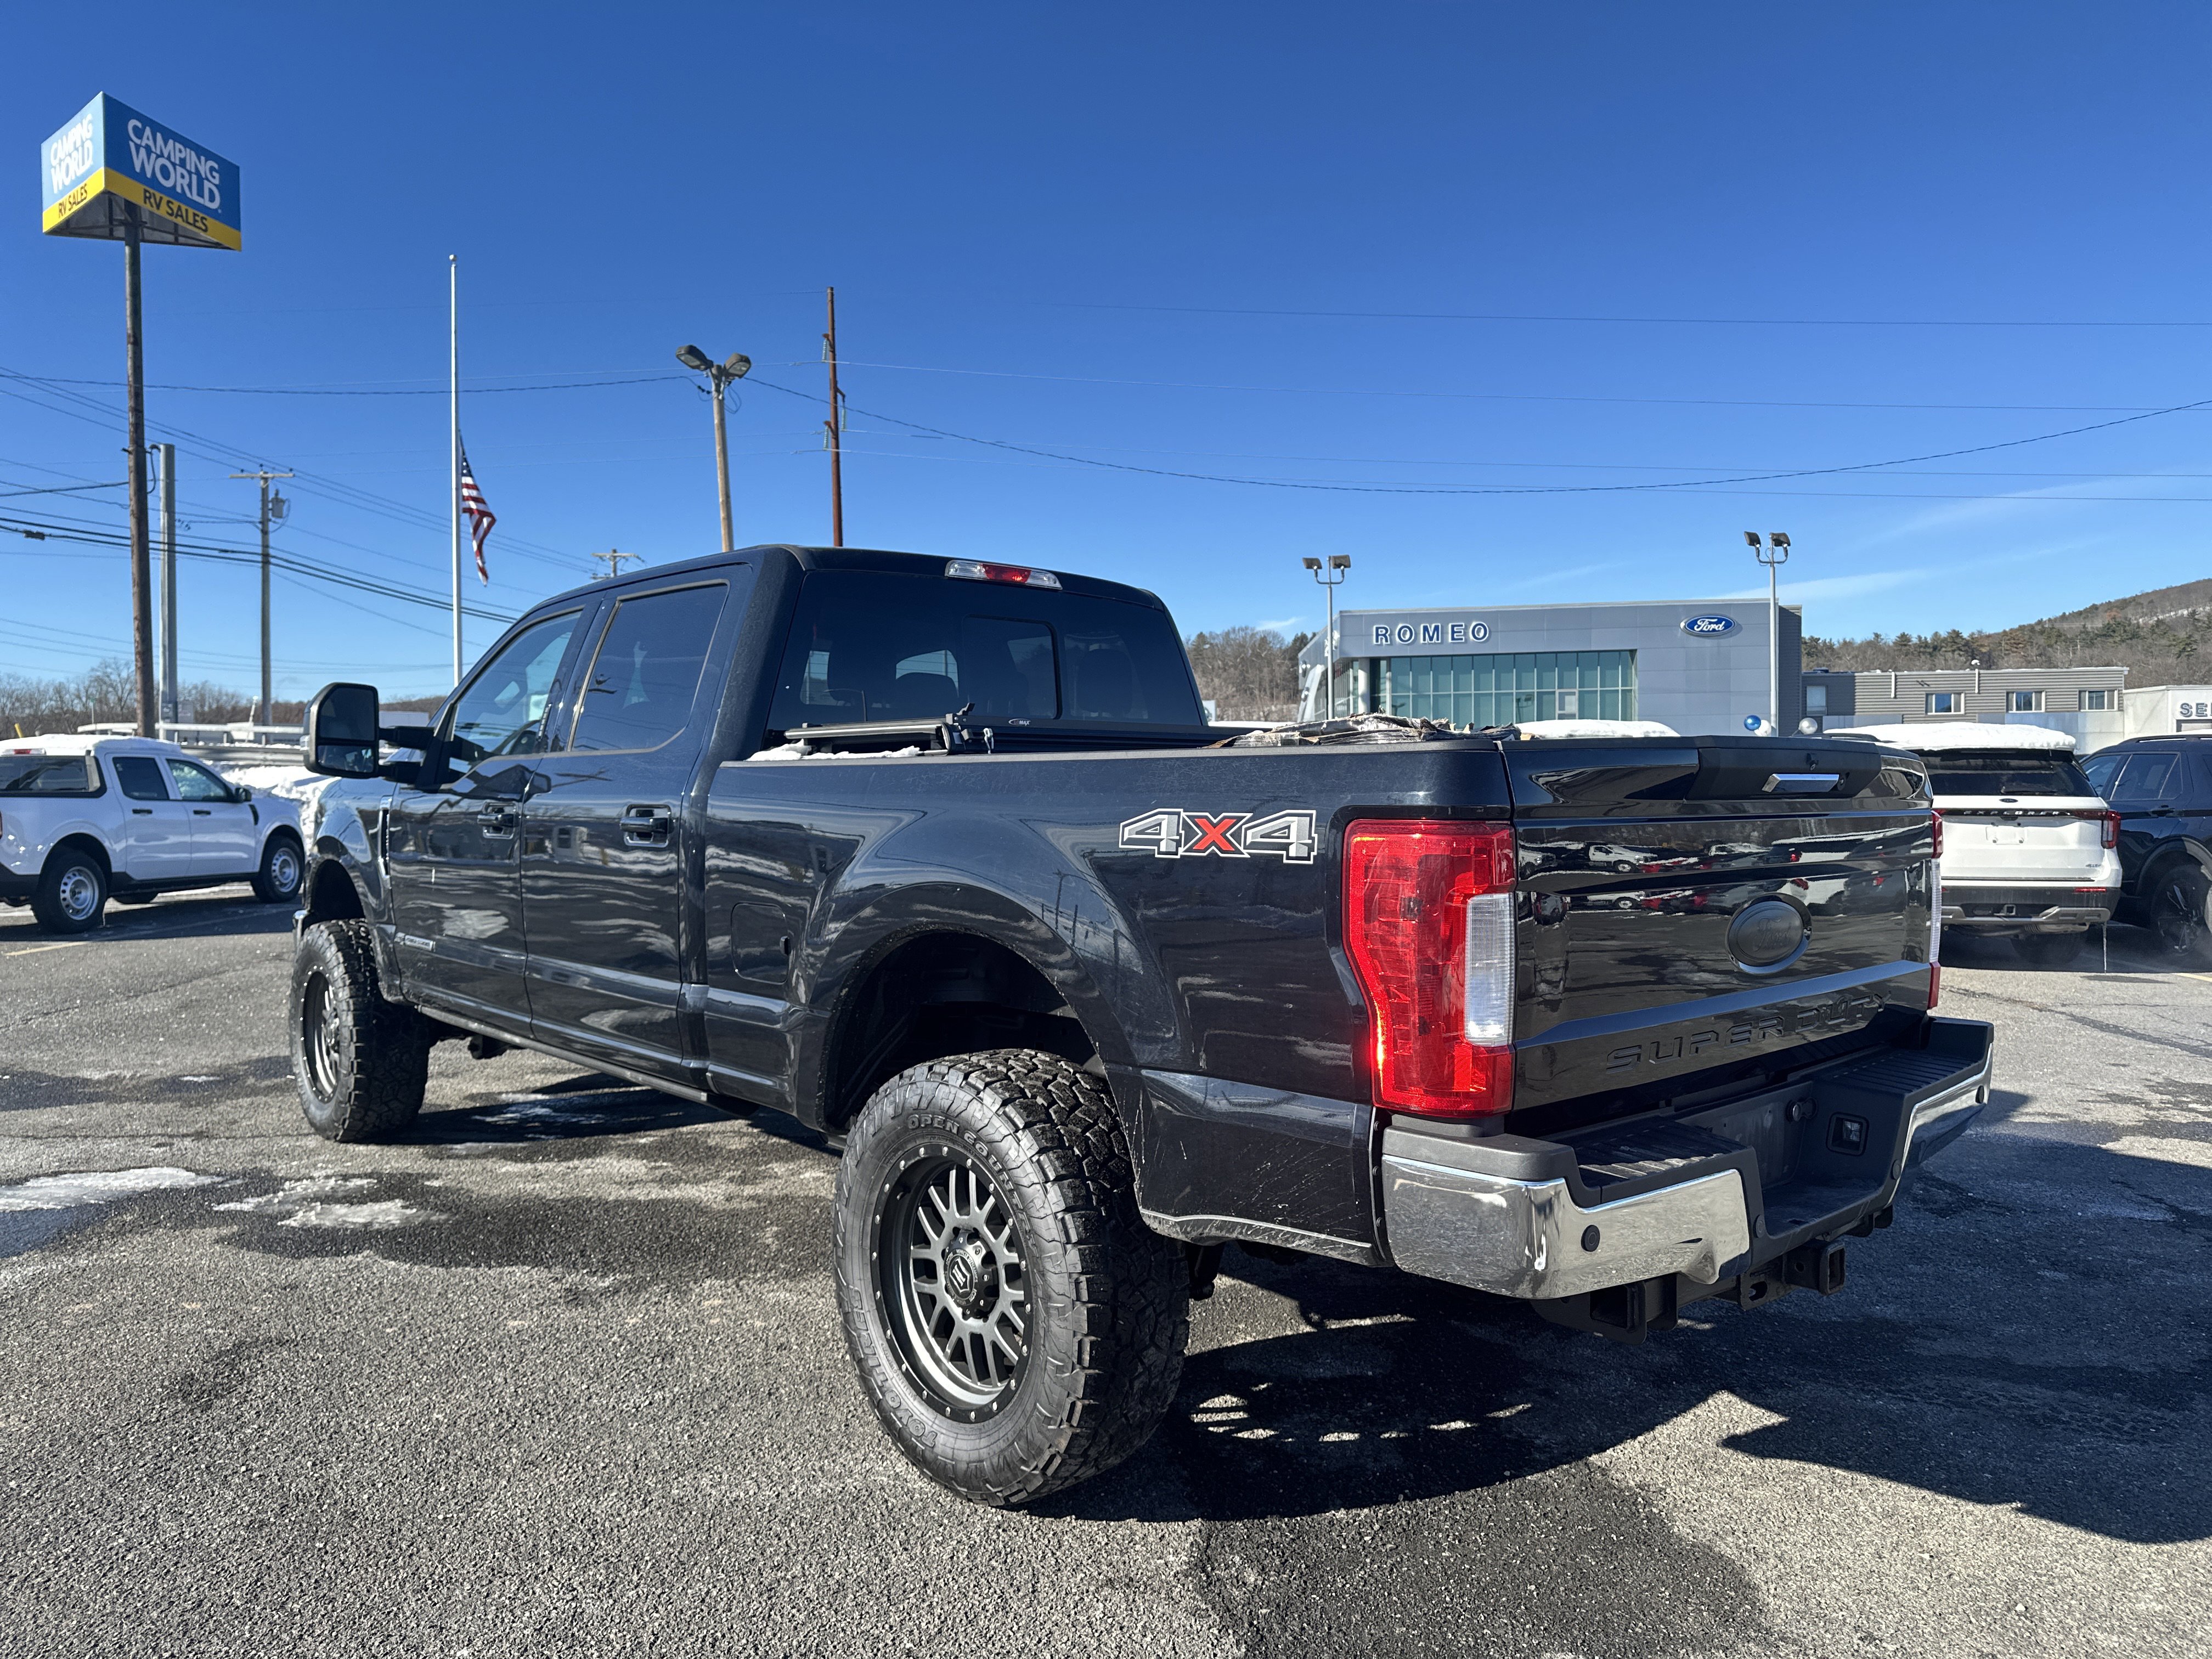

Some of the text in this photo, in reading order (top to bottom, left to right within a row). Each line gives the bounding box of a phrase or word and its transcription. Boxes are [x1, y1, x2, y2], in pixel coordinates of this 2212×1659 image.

[50, 113, 93, 166] CAMPING
[50, 139, 93, 194] WORLD
[127, 119, 219, 185] CAMPING
[58, 183, 88, 219] RV SALES
[129, 140, 221, 209] WORLD
[143, 188, 208, 233] RV SALES
[1373, 621, 1489, 645] ROMEO
[1694, 618, 1725, 631] Ford
[1606, 990, 1892, 1075] SUPER DUTY
[907, 1114, 960, 1135] OPEN
[850, 1287, 888, 1387] TIRES
[884, 1389, 938, 1448] TOYO
